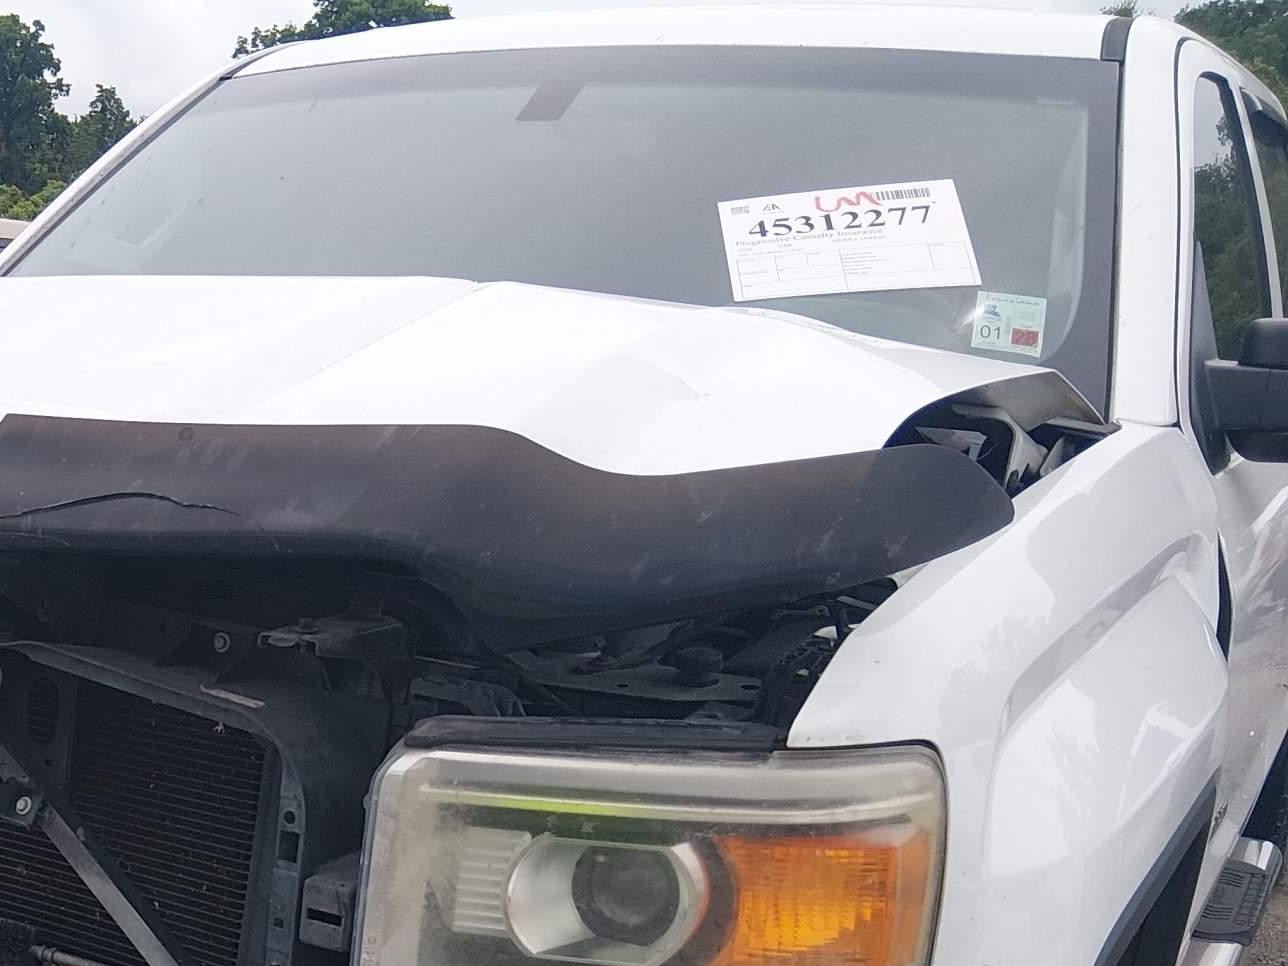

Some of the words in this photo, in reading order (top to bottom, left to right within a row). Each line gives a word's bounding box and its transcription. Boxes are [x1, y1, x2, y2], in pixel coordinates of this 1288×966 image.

[748, 205, 931, 238] 45312277
[792, 231, 834, 242] Casualty
[836, 228, 884, 237] Insurance
[980, 325, 1002, 340] 01
